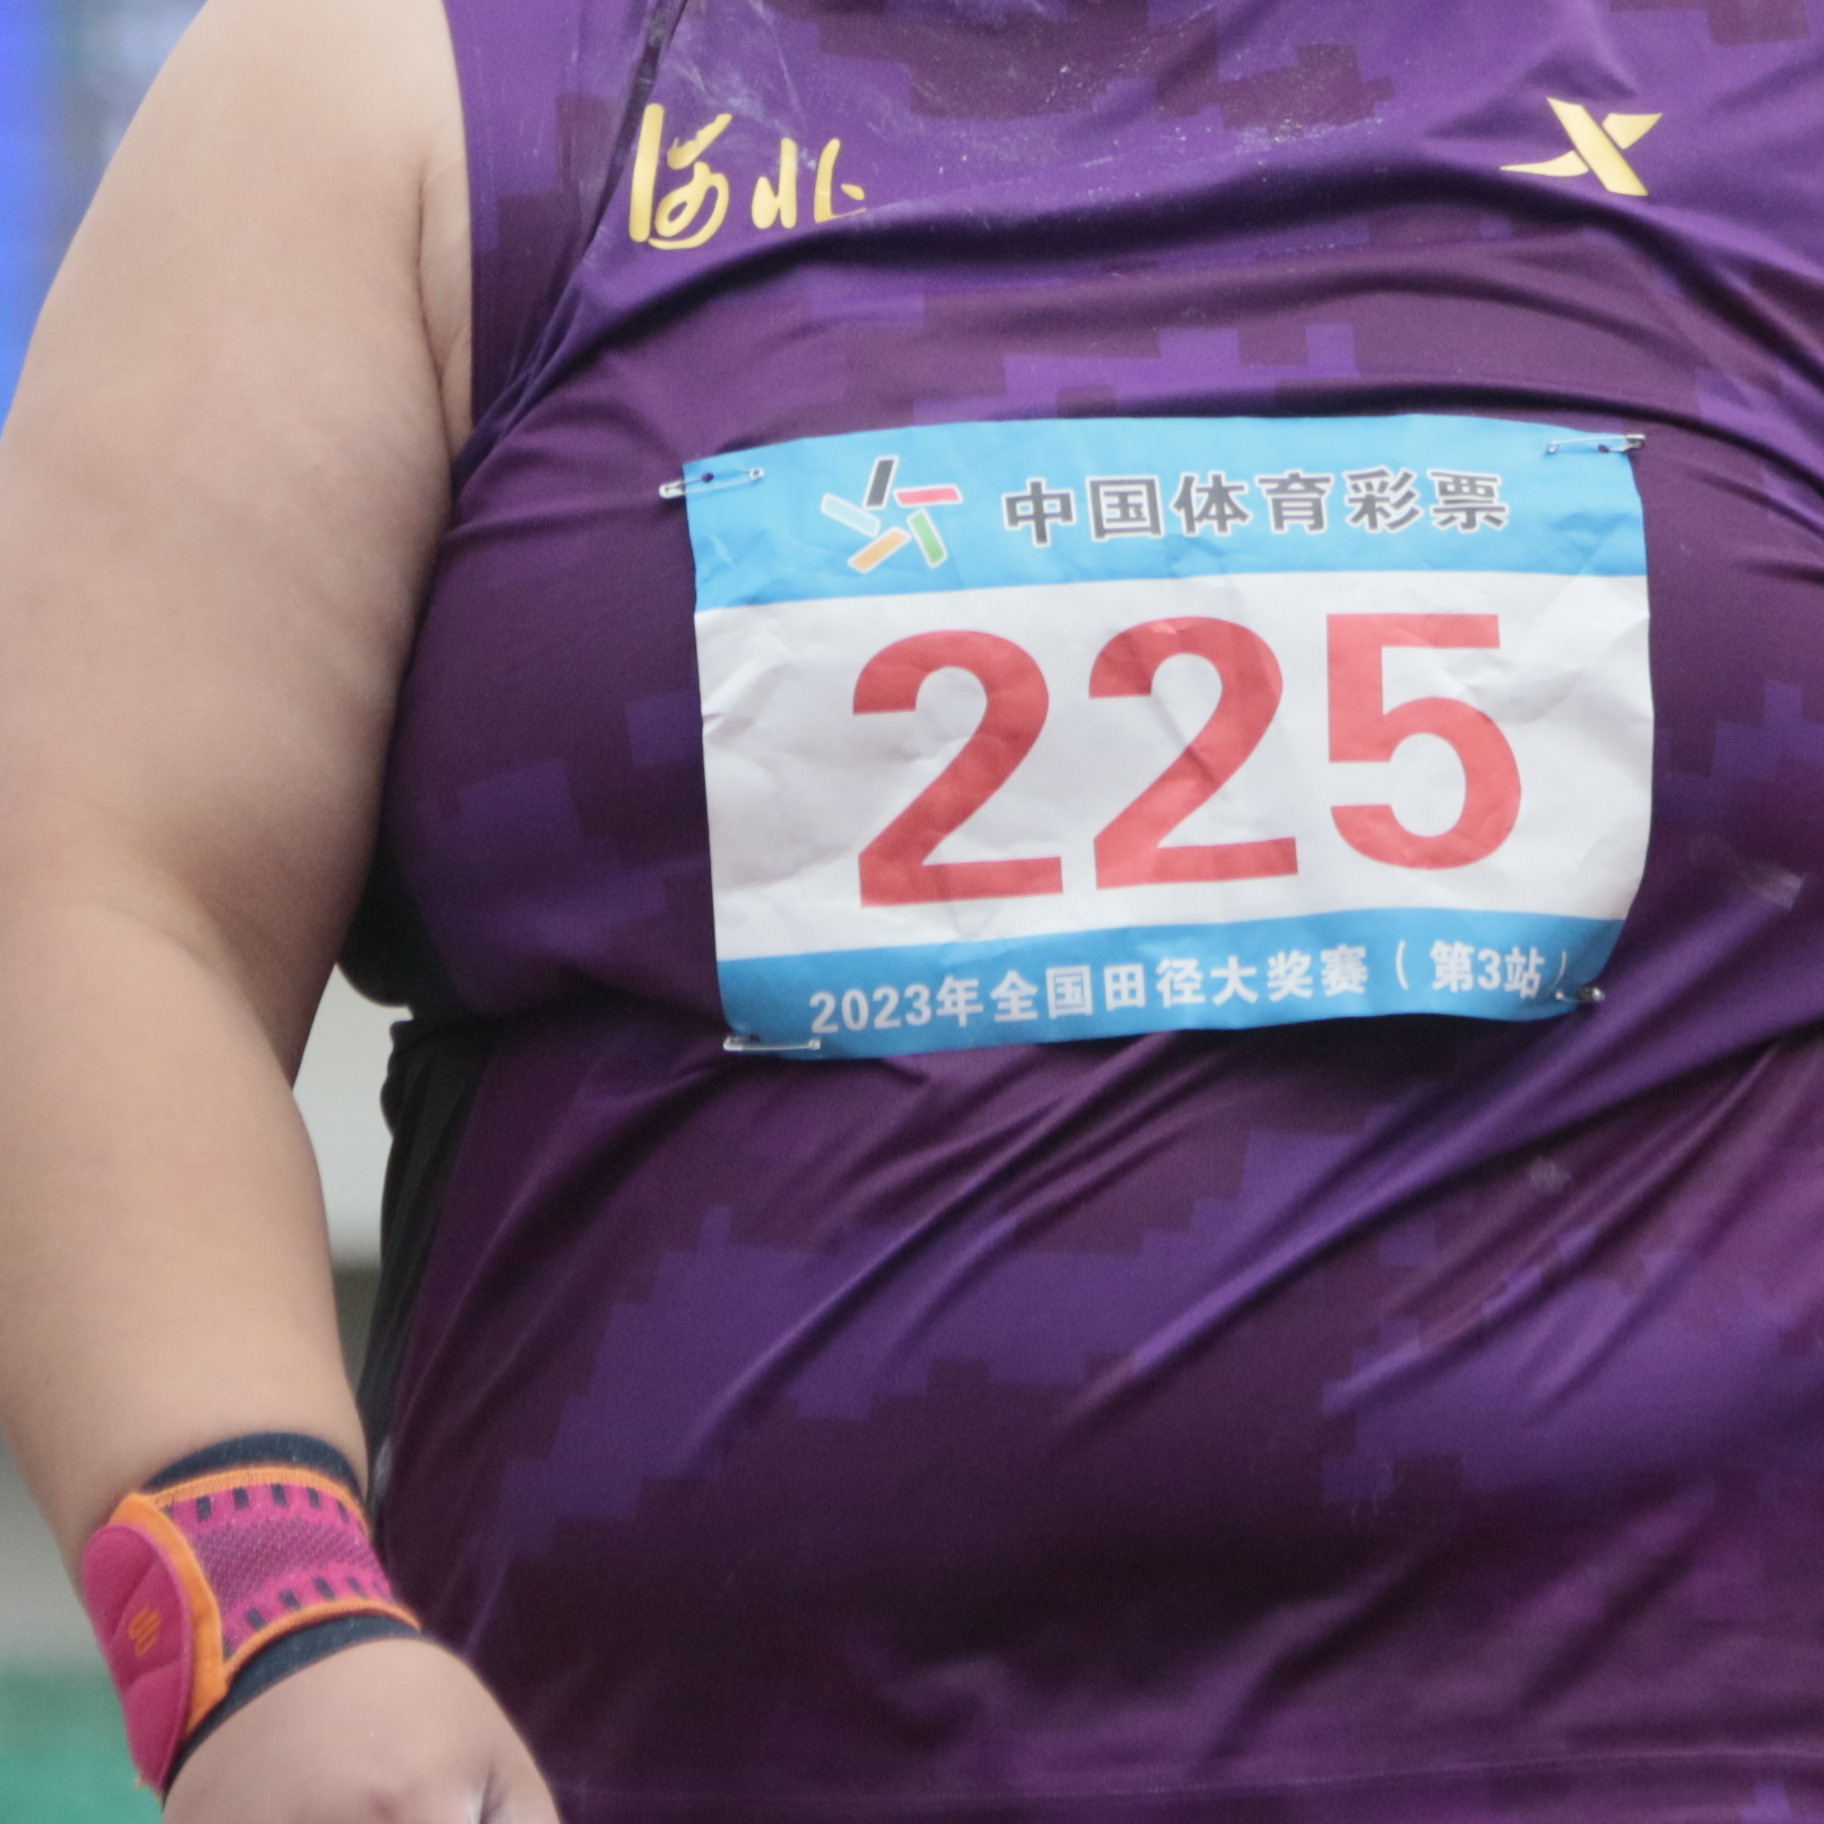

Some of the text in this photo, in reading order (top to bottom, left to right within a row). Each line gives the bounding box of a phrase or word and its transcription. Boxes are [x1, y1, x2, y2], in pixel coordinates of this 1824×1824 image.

[1002, 469, 1508, 547] 中国体育彩票
[852, 612, 1522, 908] 225
